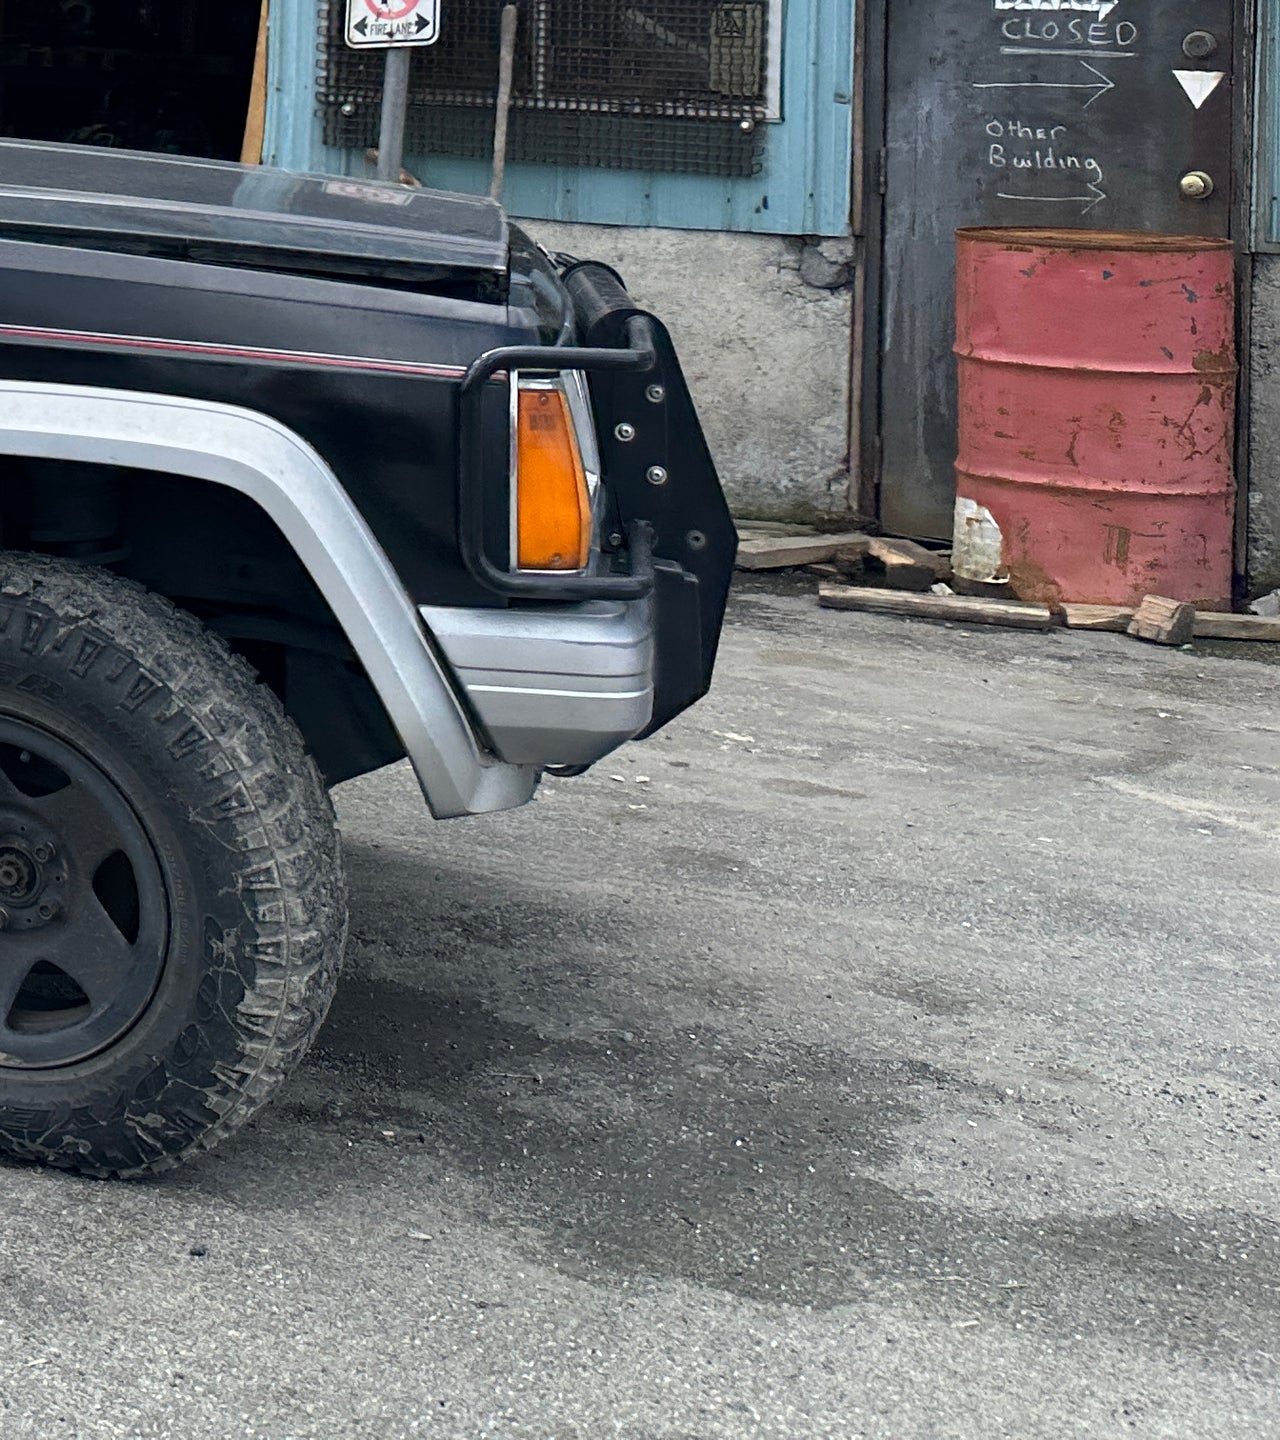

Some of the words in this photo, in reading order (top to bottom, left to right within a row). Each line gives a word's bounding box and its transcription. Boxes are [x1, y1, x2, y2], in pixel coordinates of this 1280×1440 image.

[370, 23, 388, 36] FIRE
[389, 21, 414, 36] LANE
[1001, 16, 1138, 46] CLOSED
[988, 144, 1104, 185] Building
